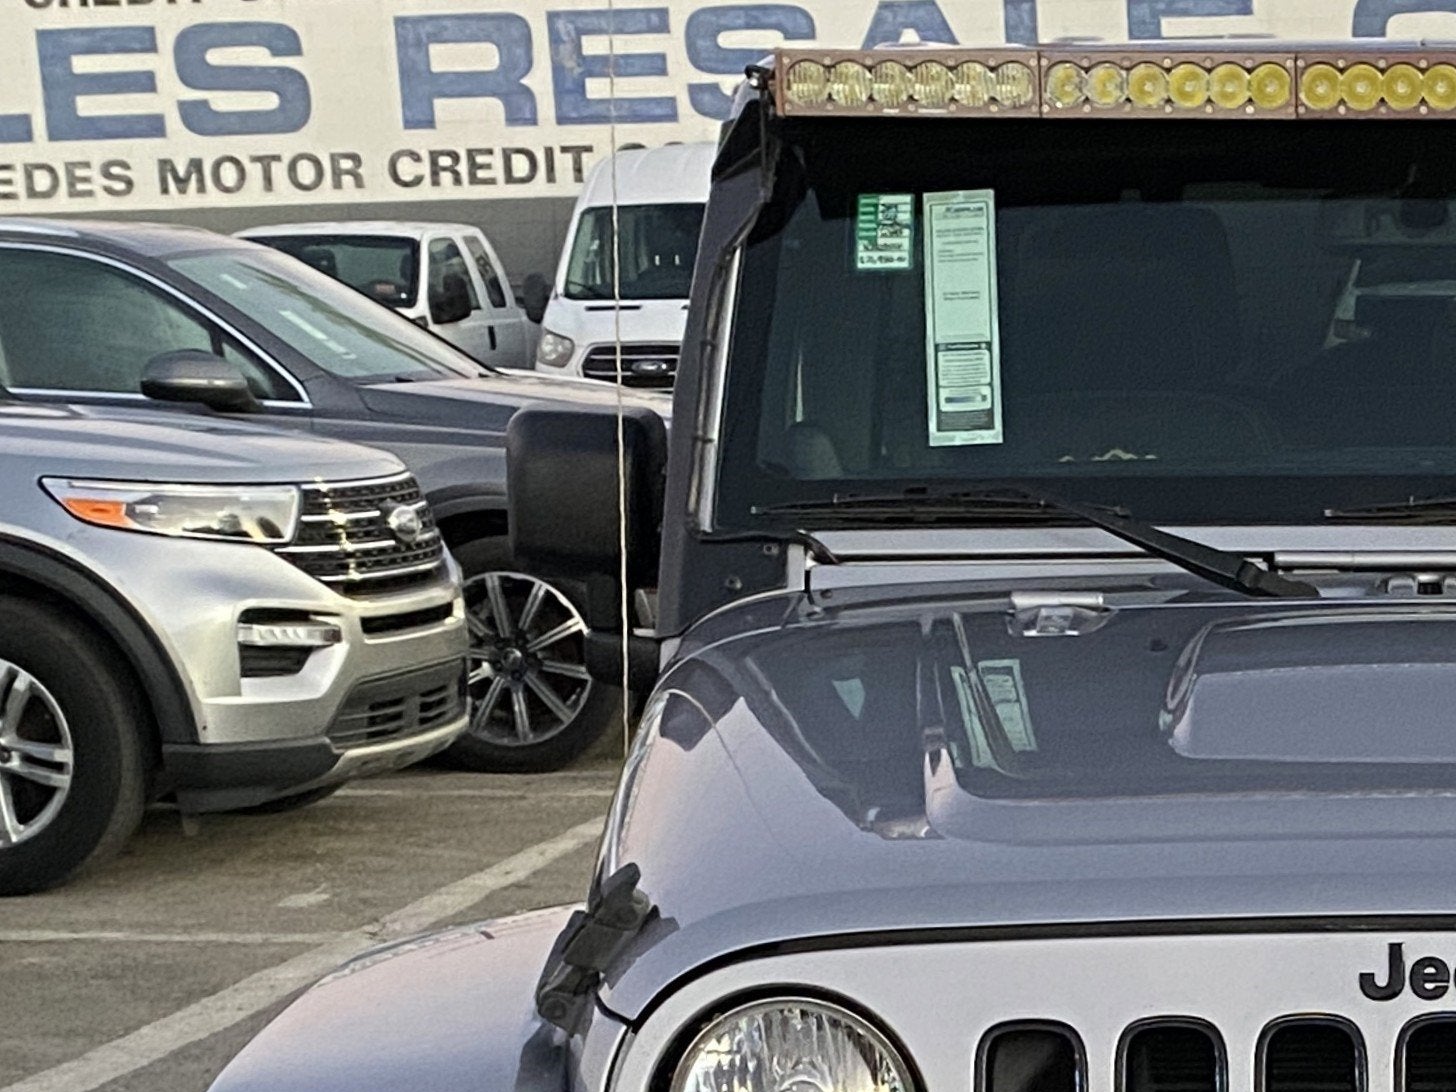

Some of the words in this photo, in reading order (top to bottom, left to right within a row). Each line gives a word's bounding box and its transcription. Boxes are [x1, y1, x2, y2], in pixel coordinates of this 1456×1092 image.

[0, 21, 312, 143] ES
[157, 152, 365, 196] MOTOR
[387, 144, 594, 188] CREDIT
